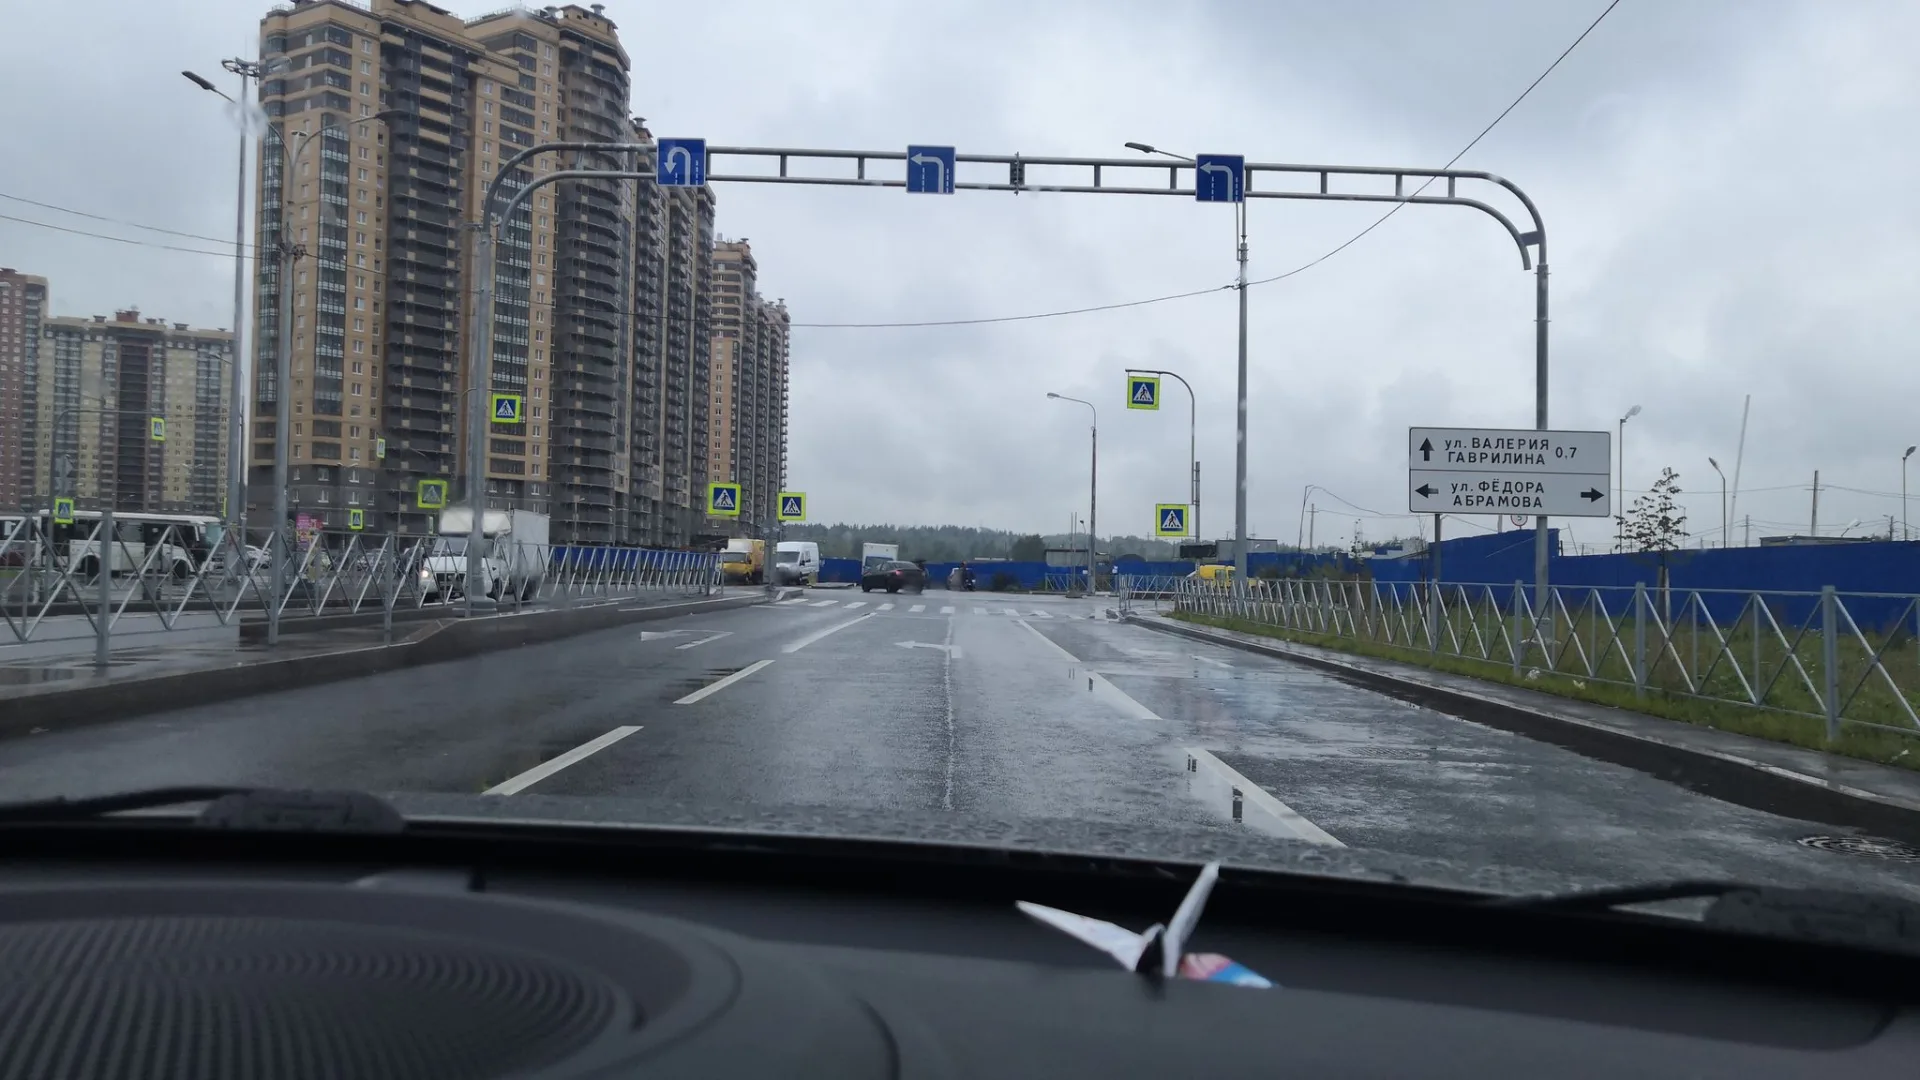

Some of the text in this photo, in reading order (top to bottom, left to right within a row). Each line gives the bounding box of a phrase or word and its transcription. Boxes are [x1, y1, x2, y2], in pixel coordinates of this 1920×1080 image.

[1445, 437, 1549, 451] ул. ВАЛЕРИЯ
[1448, 451, 1546, 465] ГАВРИЛИНА
[1451, 478, 1545, 495] ул. ФЁДОРА
[1453, 495, 1543, 508] АБРАМОВА
